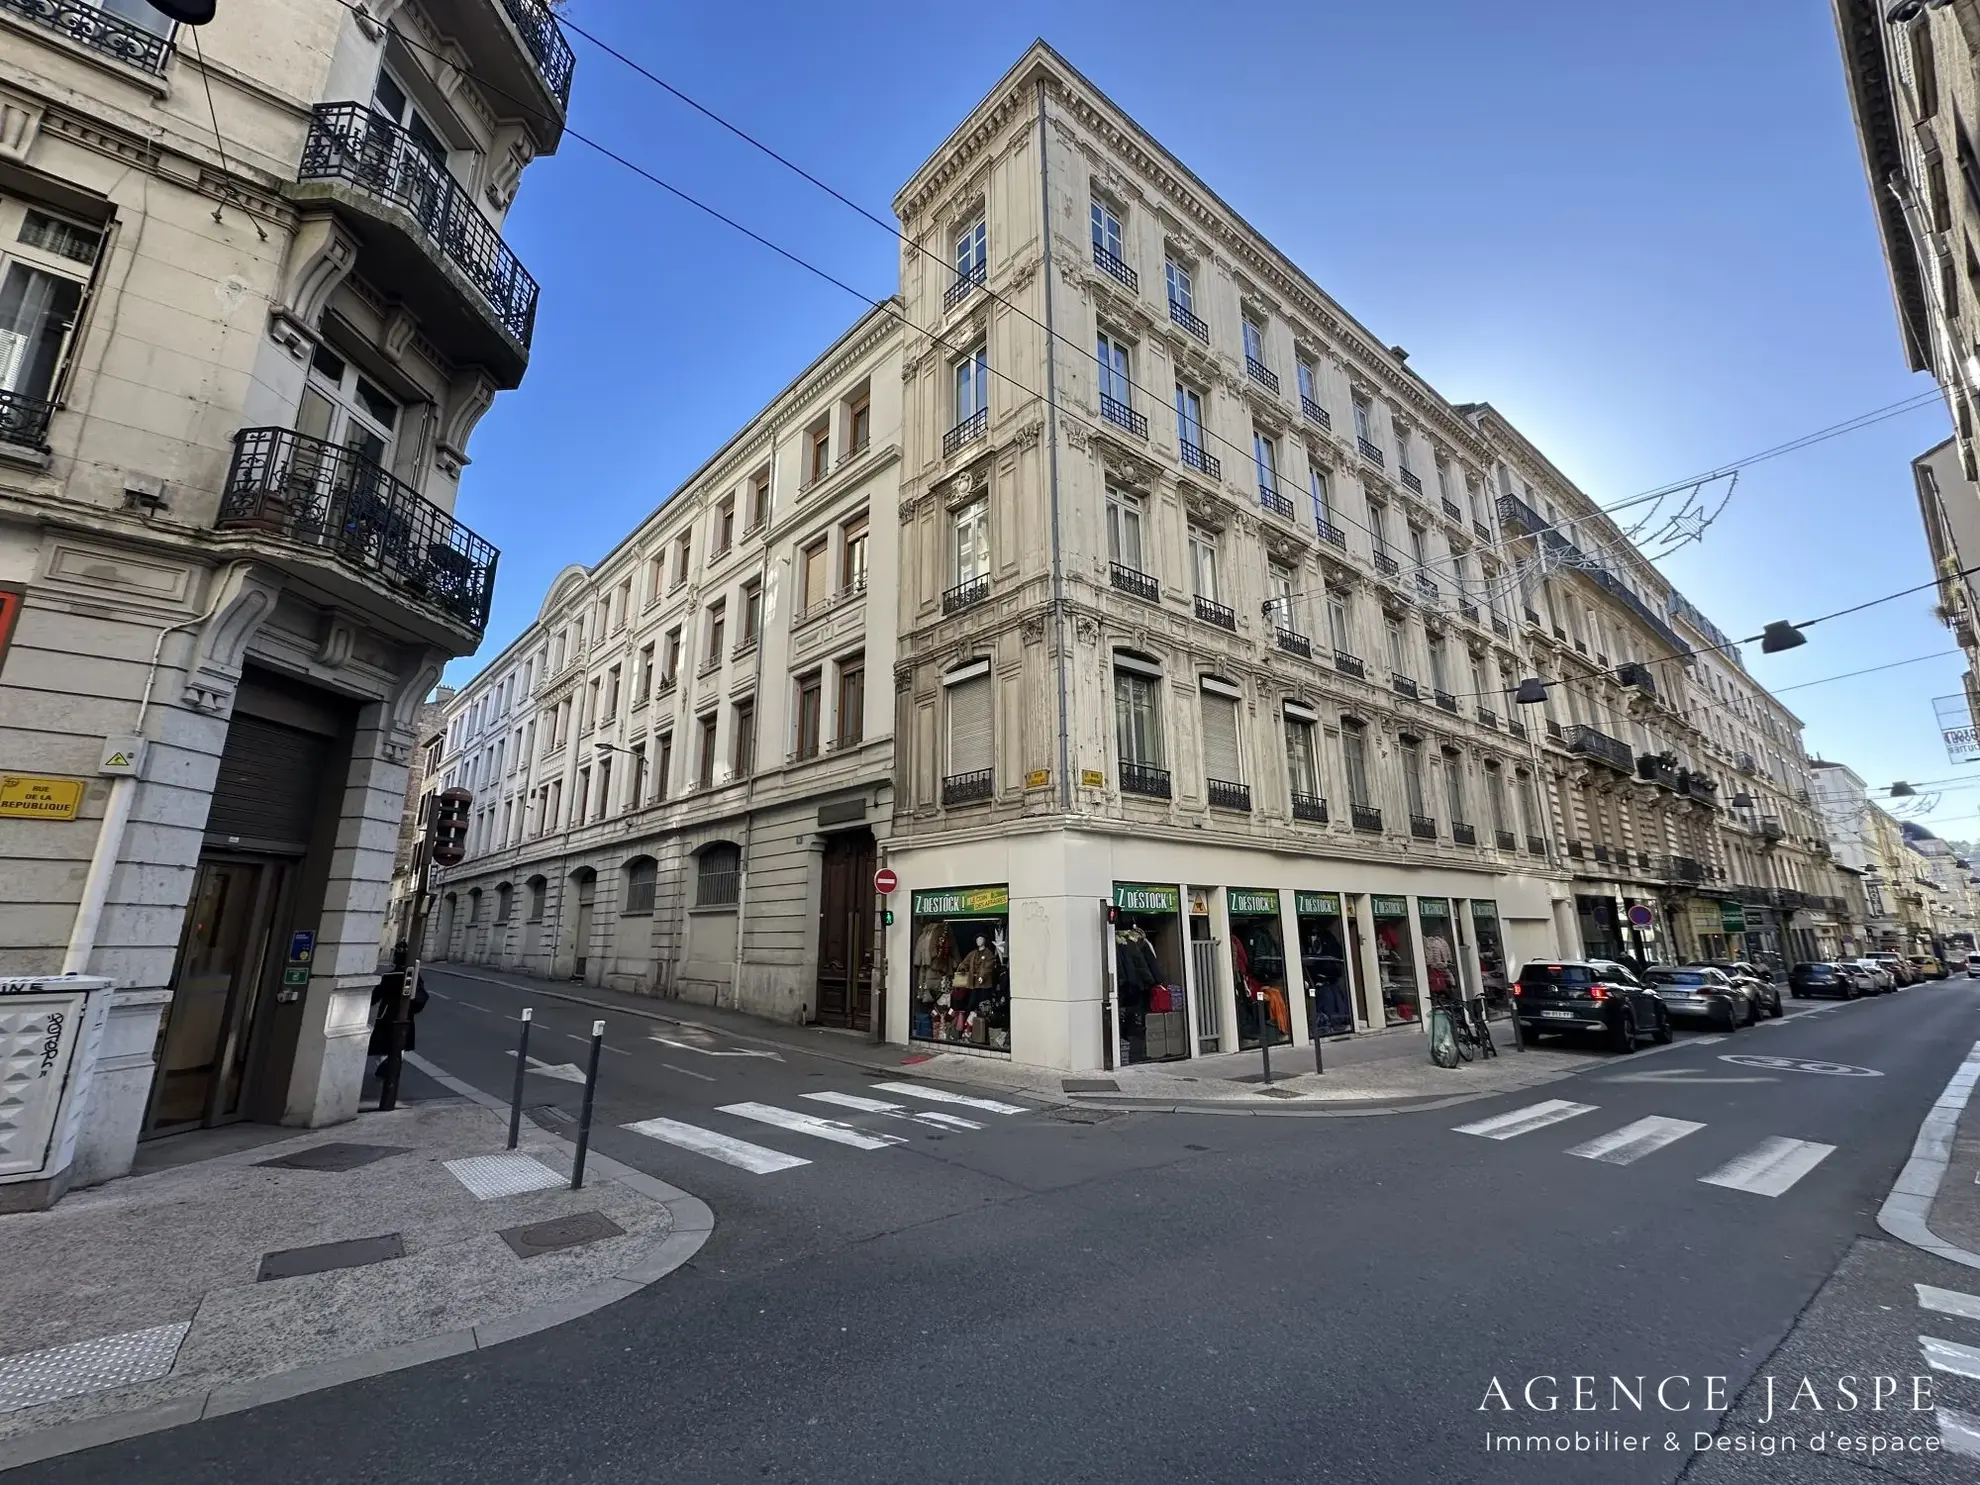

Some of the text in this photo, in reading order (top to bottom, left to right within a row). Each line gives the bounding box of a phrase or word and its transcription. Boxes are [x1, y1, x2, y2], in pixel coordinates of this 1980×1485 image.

[1, 801, 71, 811] REPUBLIQUE
[915, 895, 922, 914] Z
[1117, 887, 1125, 908] Z
[1231, 892, 1238, 911] Z
[1299, 895, 1305, 912] Z
